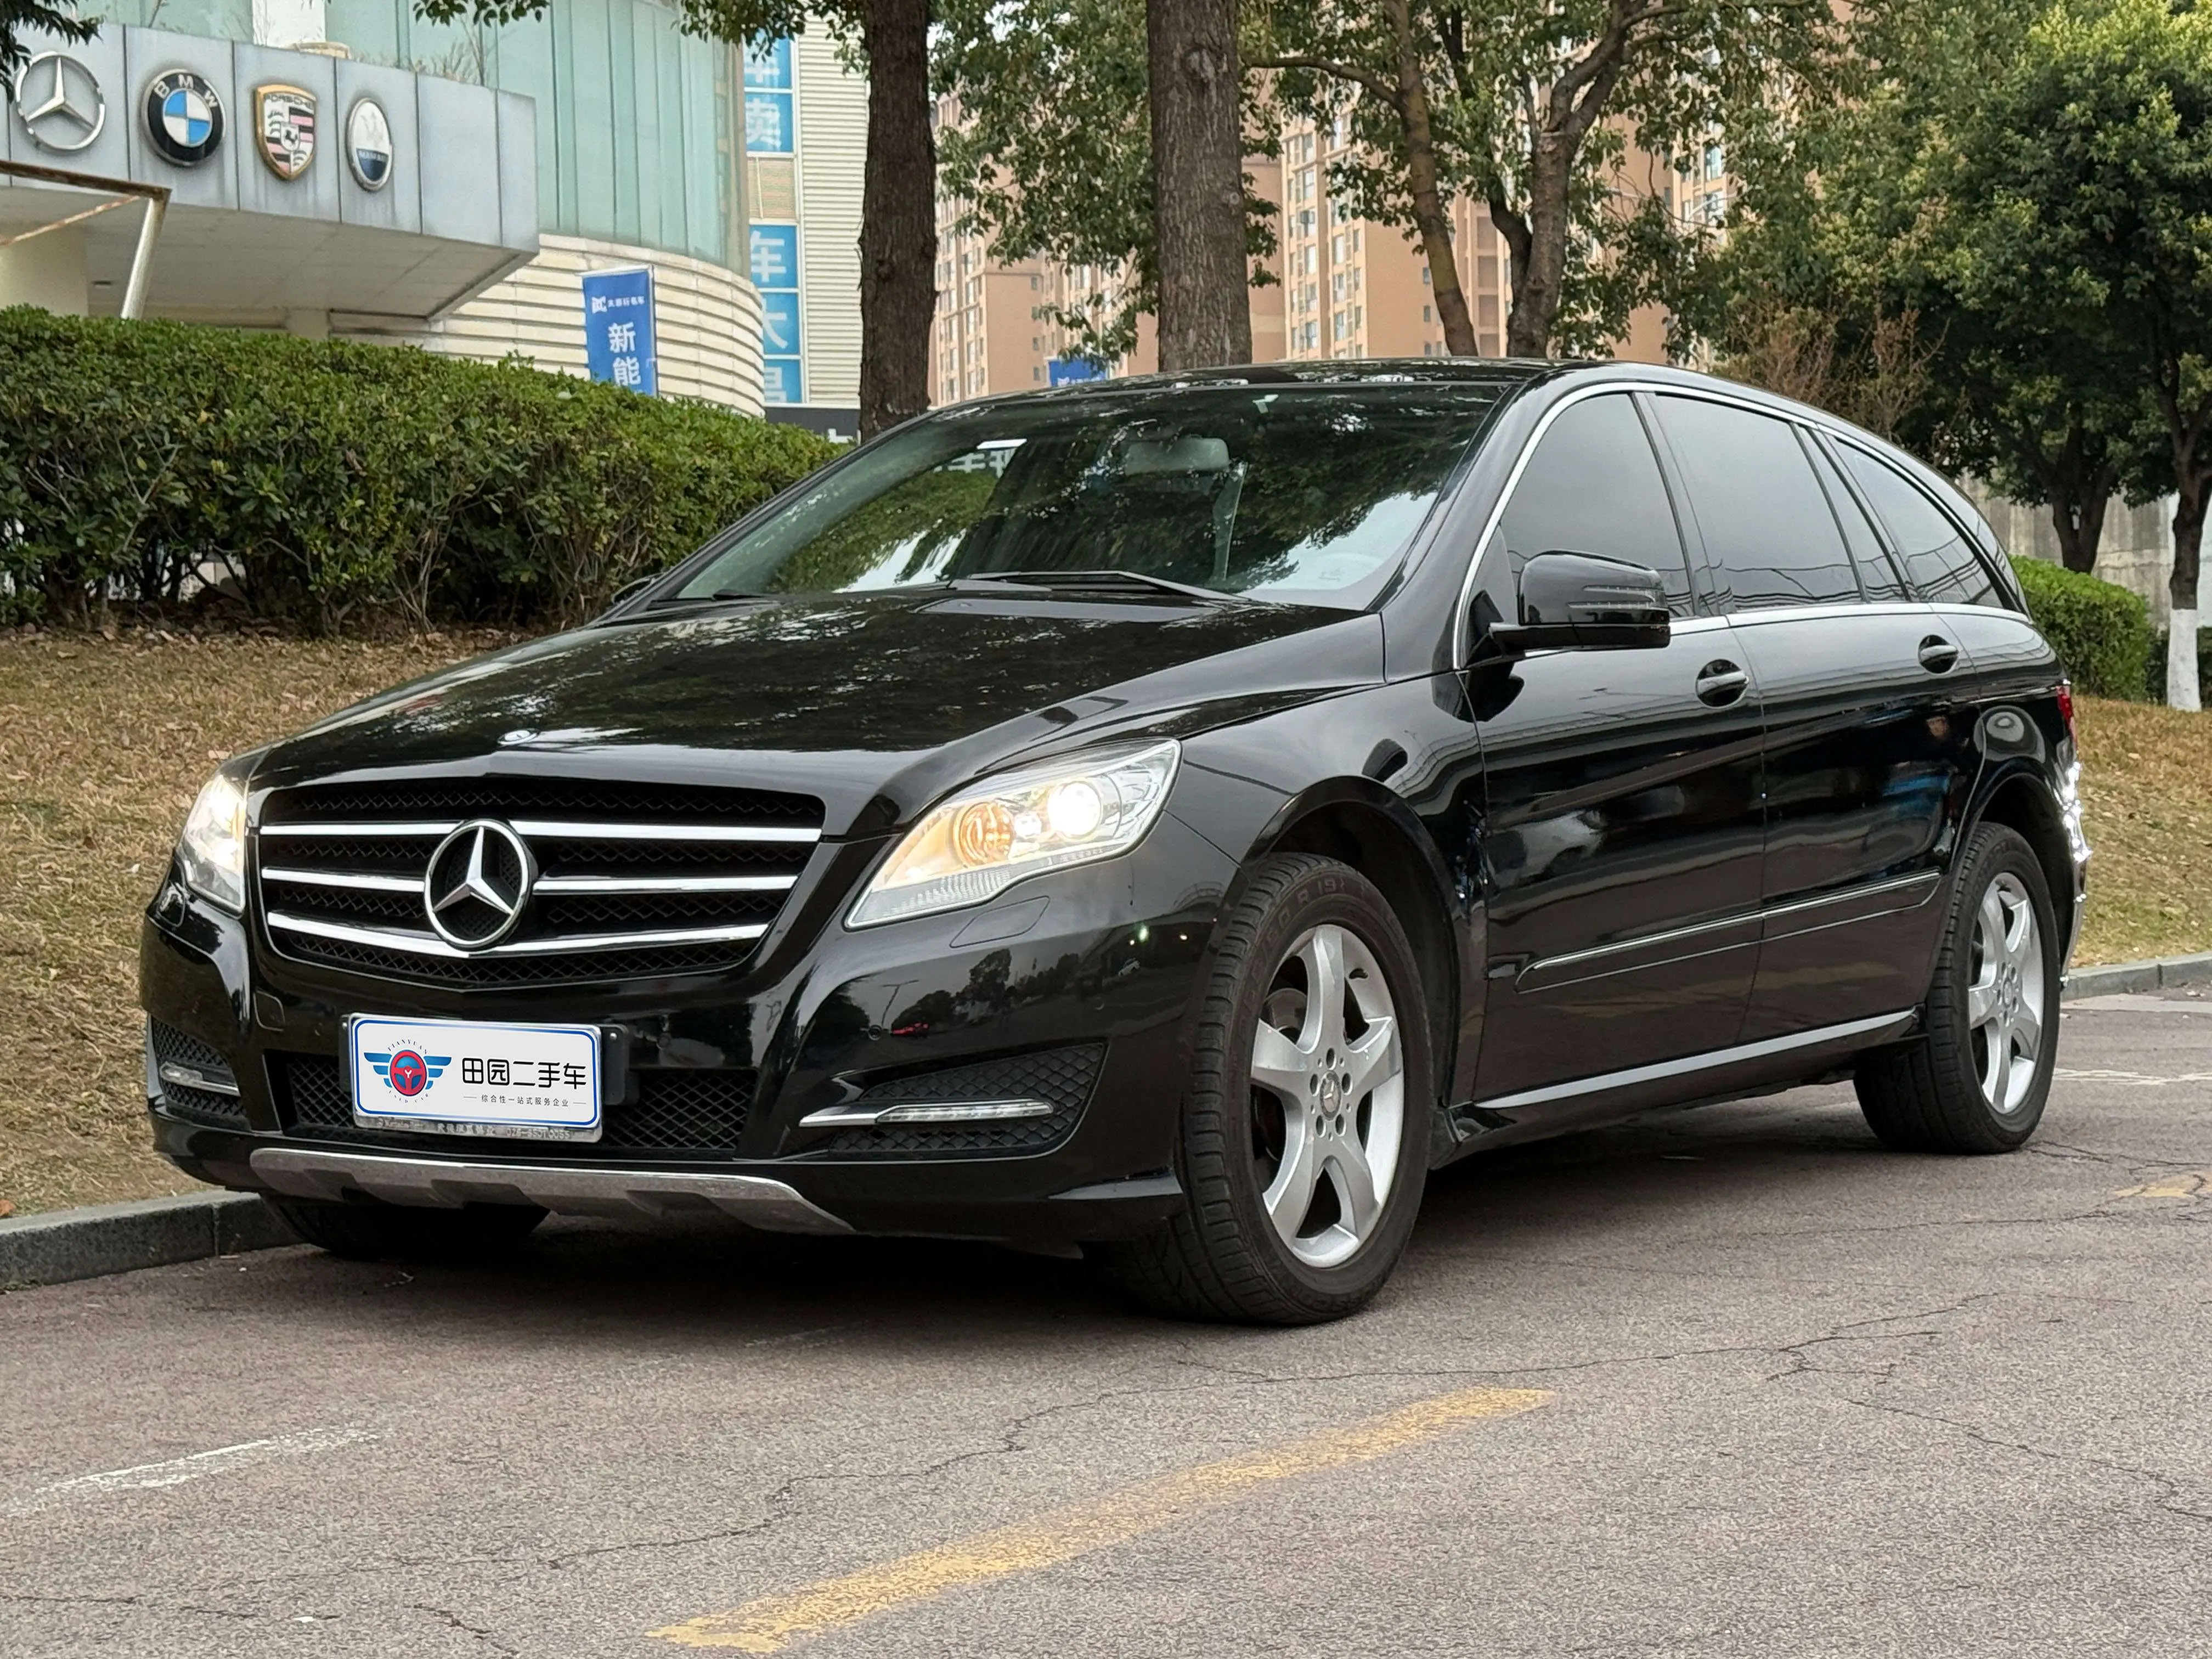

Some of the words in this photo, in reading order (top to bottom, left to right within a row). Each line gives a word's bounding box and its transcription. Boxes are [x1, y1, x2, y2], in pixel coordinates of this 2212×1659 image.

[154, 74, 218, 108] BMW
[608, 321, 642, 392] 新能
[462, 1057, 586, 1090] 田园二手车
[481, 1094, 569, 1107] 综合性一站式服务企业
